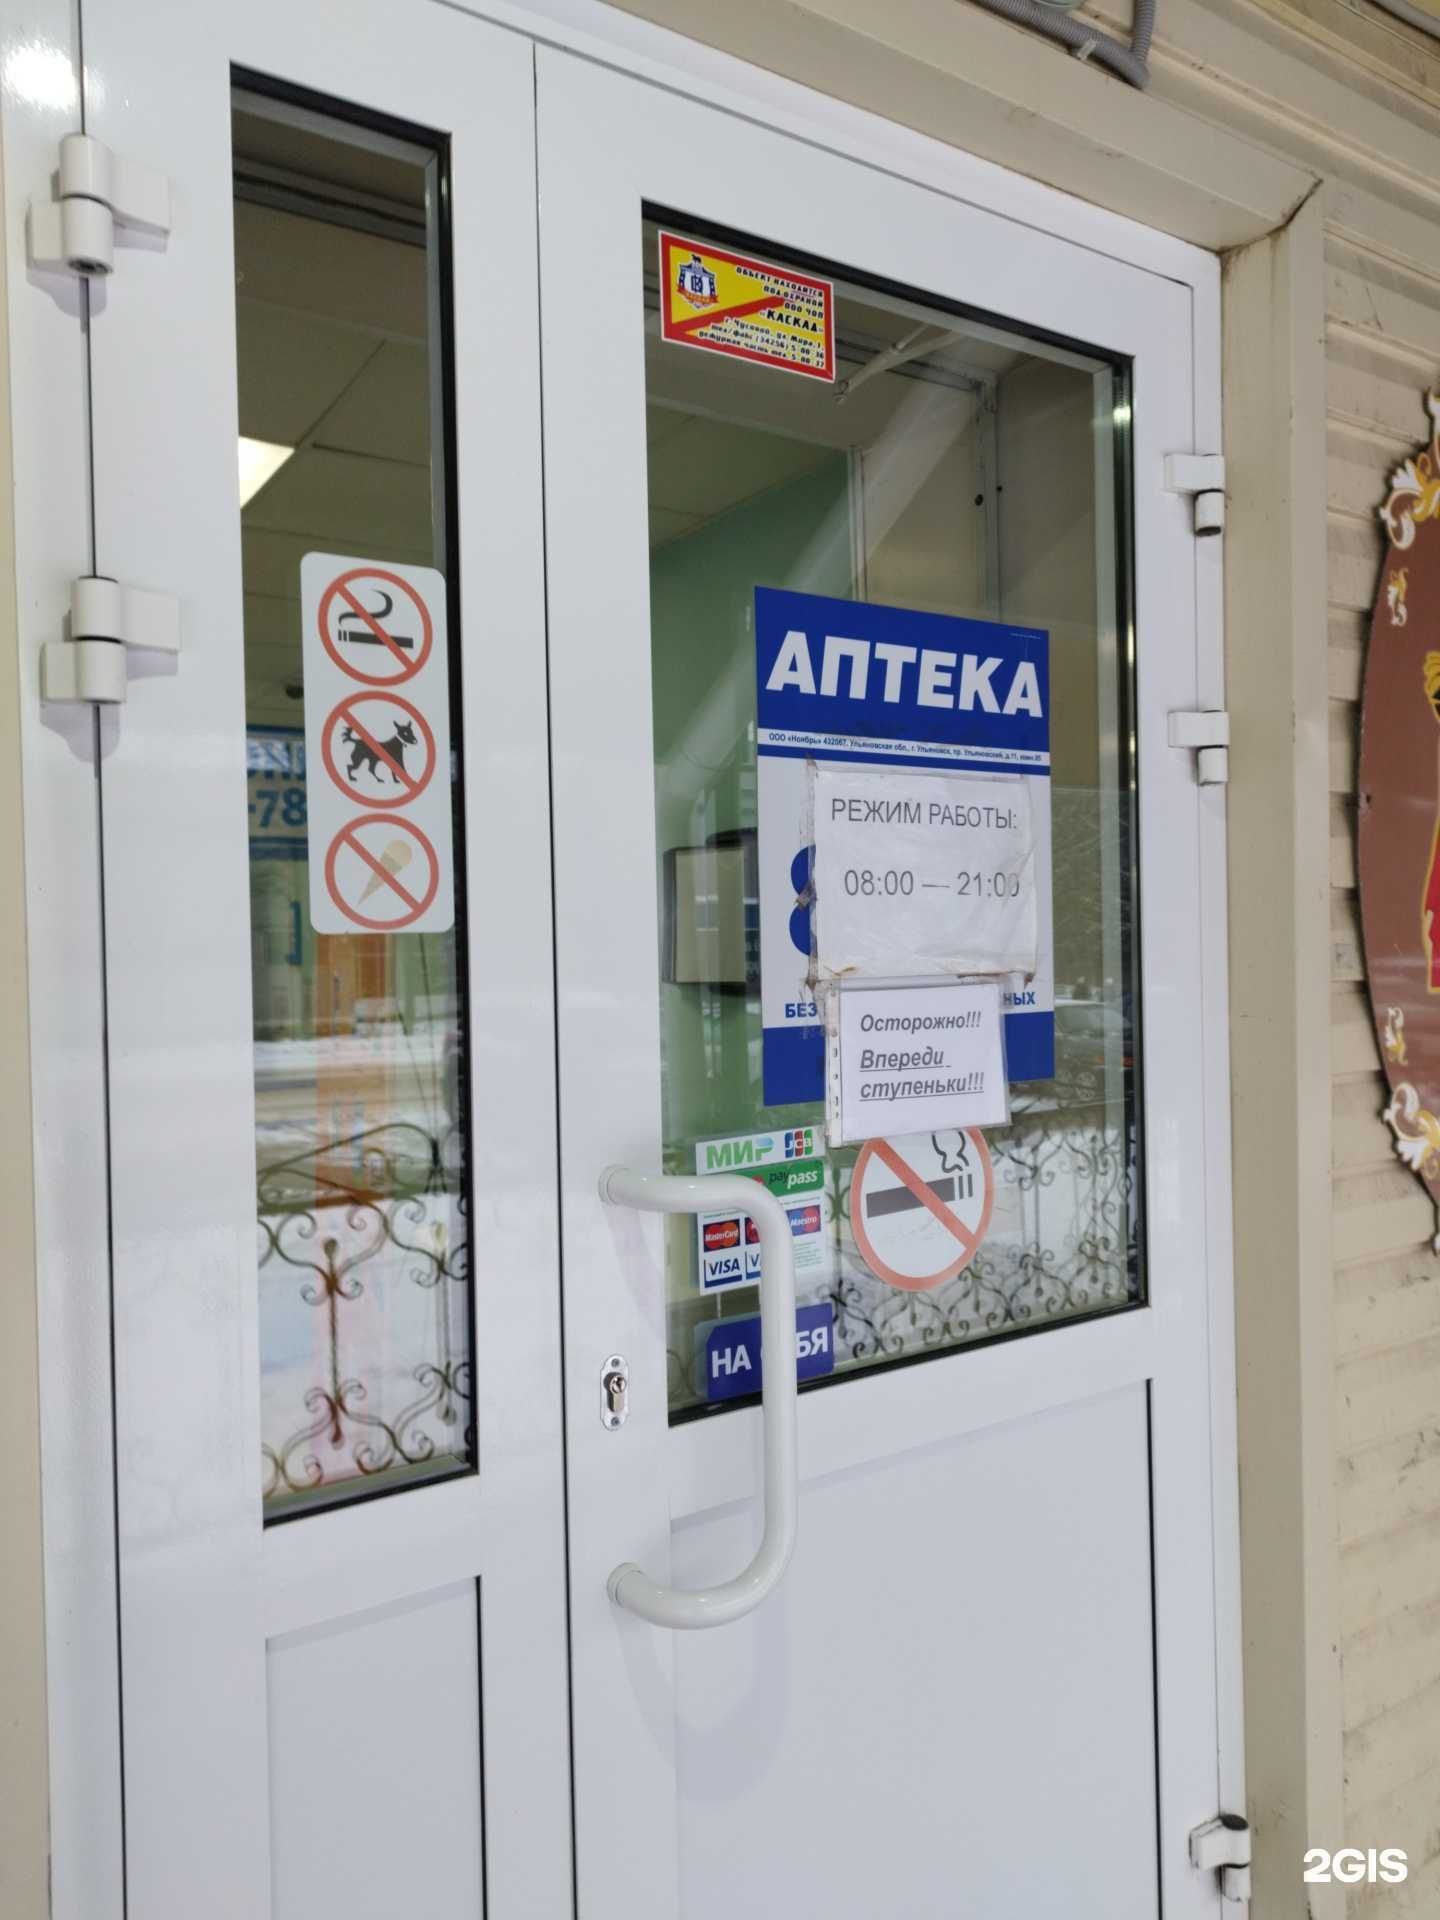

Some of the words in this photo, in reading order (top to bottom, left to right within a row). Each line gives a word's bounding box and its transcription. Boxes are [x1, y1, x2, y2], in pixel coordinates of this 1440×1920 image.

[784, 302, 803, 313] ООО
[806, 307, 823, 319] ЧОП
[765, 630, 1043, 718] АПТЕКА
[768, 732, 786, 742] ООО
[831, 798, 921, 825] РЕЖИМ
[928, 803, 1018, 829] РАБОТЫ:
[843, 869, 914, 897] 08:00
[957, 871, 1020, 898] 21:00
[785, 1001, 818, 1019] БЕЗ
[859, 1011, 982, 1035] Осторожно!!!
[859, 1046, 946, 1072] Впереди
[859, 1072, 985, 1101] ступеньки!!!
[706, 1137, 775, 1169] МИР
[704, 1228, 740, 1243] MasterCard
[709, 1258, 741, 1276] VISA
[711, 1344, 752, 1378] НА
